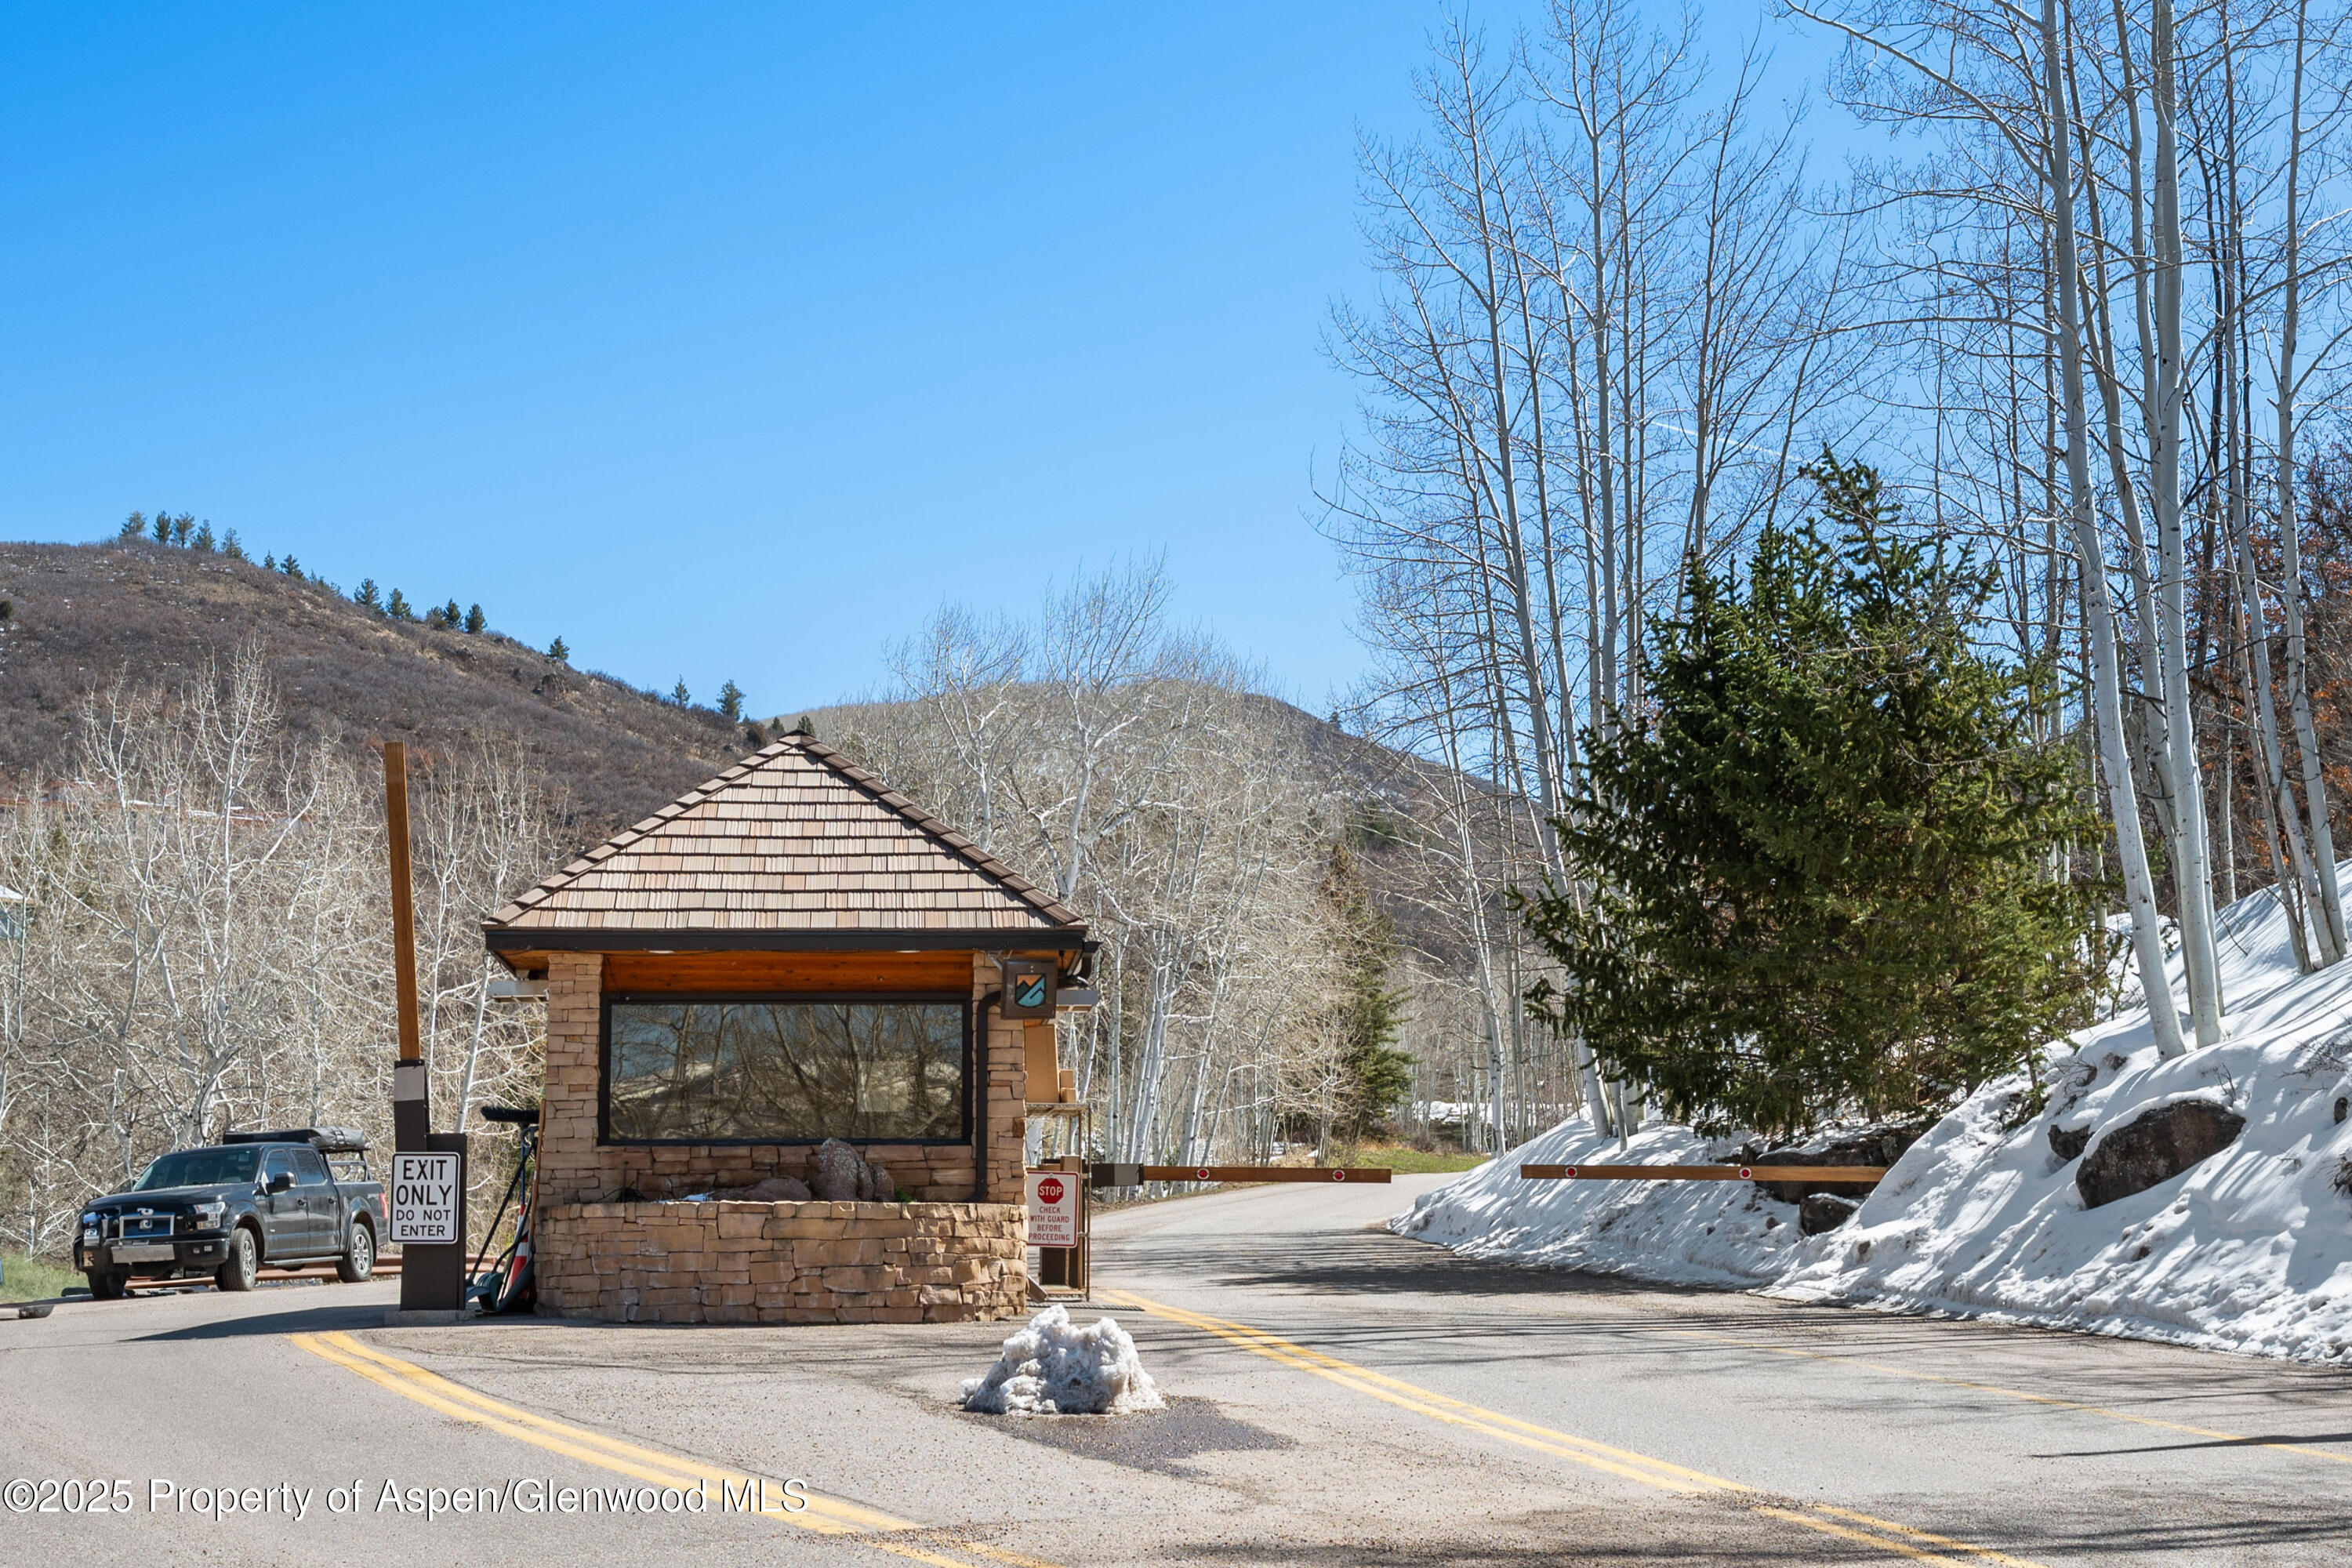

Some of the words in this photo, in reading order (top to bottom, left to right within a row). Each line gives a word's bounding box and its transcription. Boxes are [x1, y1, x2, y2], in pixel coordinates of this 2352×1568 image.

[403, 1160, 447, 1180] EXIT
[396, 1185, 452, 1205] ONLY
[1039, 1185, 1062, 1196] STOP
[396, 1210, 415, 1221] DO
[423, 1210, 451, 1221] NOT
[401, 1225, 445, 1236] ENTER
[1029, 1232, 1070, 1241] PROCEEDING
